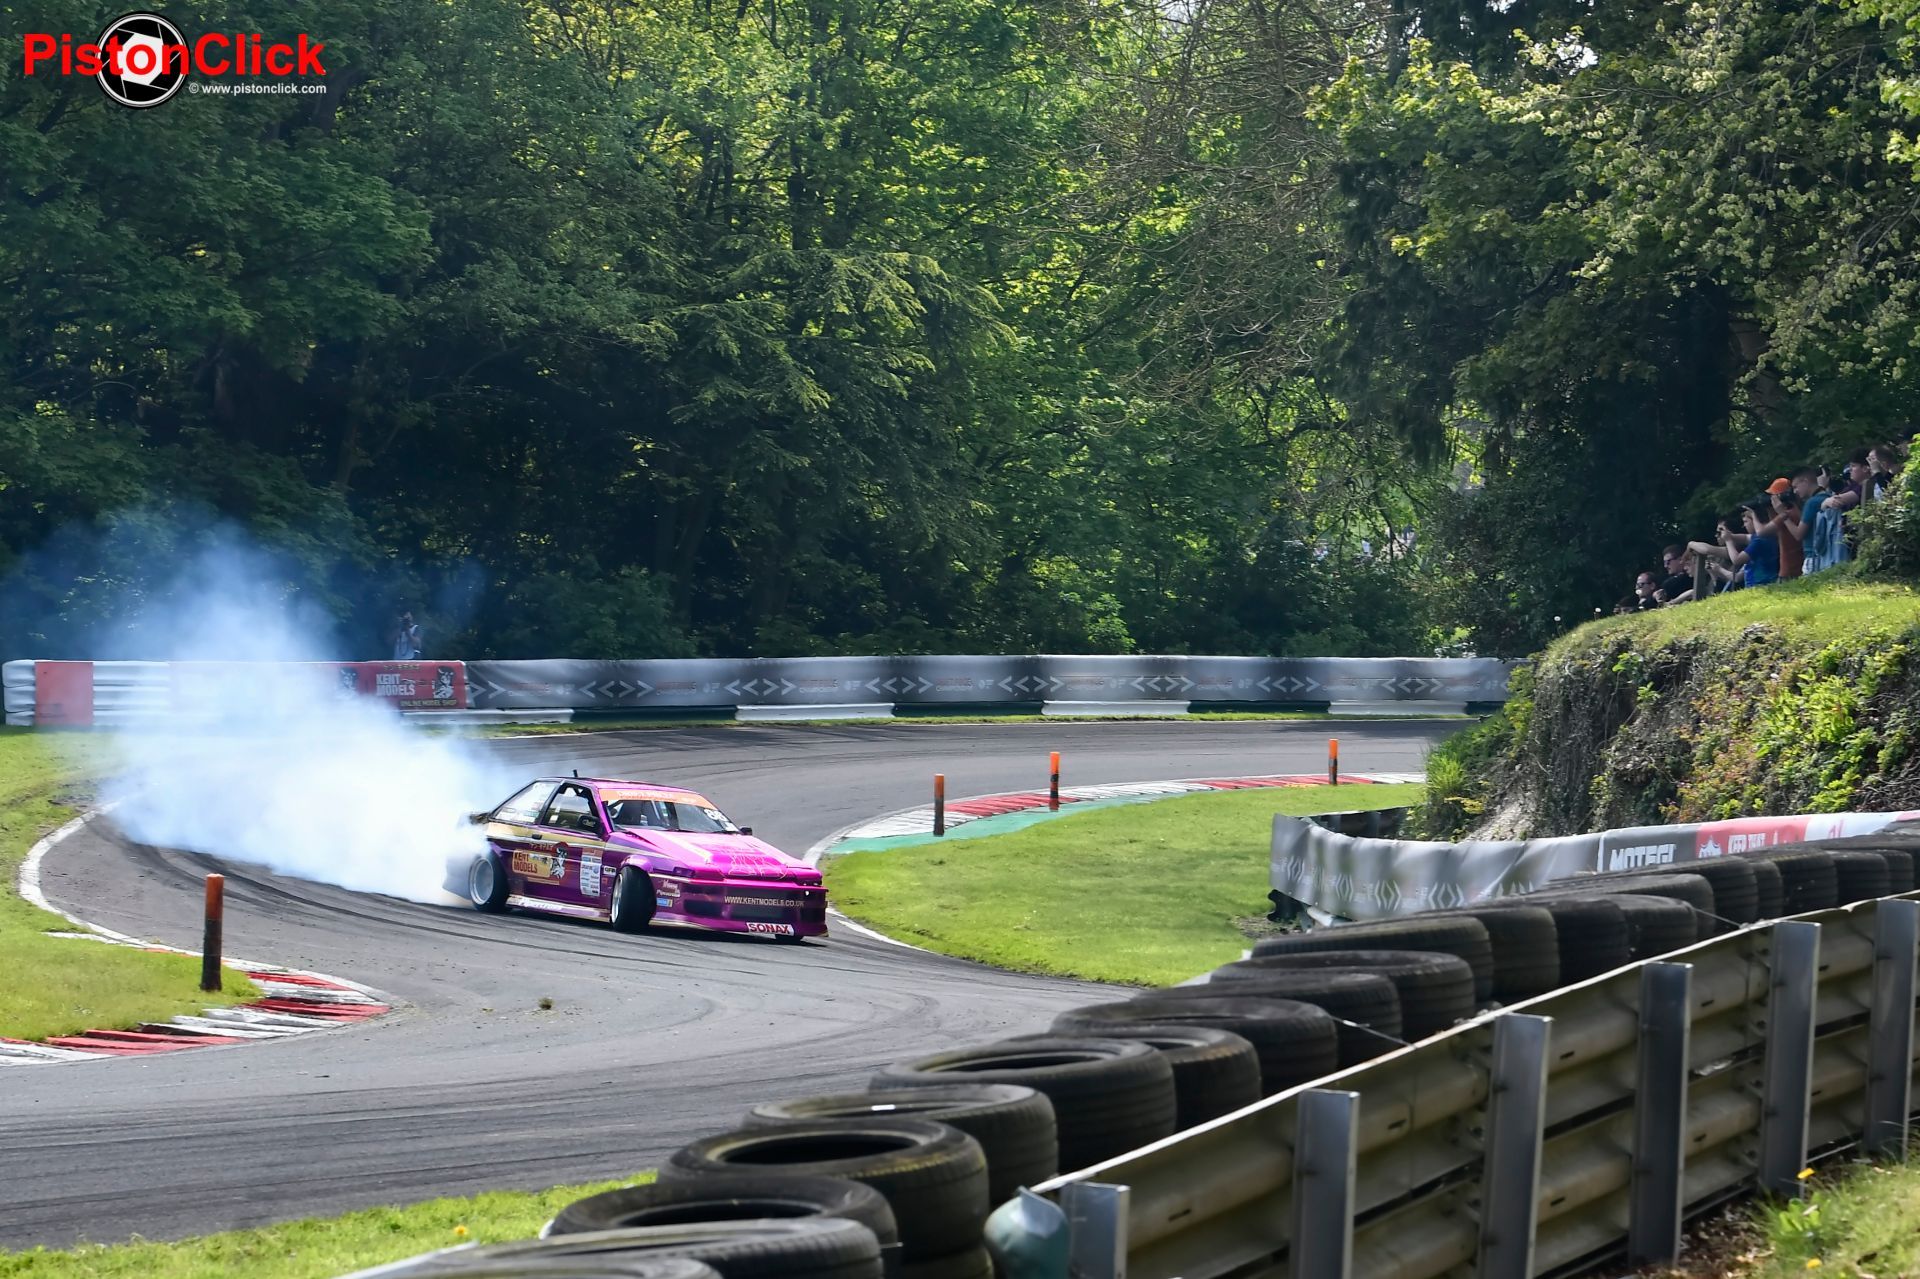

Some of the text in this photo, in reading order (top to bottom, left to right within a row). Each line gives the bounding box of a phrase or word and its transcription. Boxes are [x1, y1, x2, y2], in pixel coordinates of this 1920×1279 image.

[376, 673, 400, 685] KENT
[376, 684, 416, 697] MODELS
[514, 852, 529, 862] KENT
[514, 860, 538, 874] MODELS
[748, 923, 790, 934] SONAX
